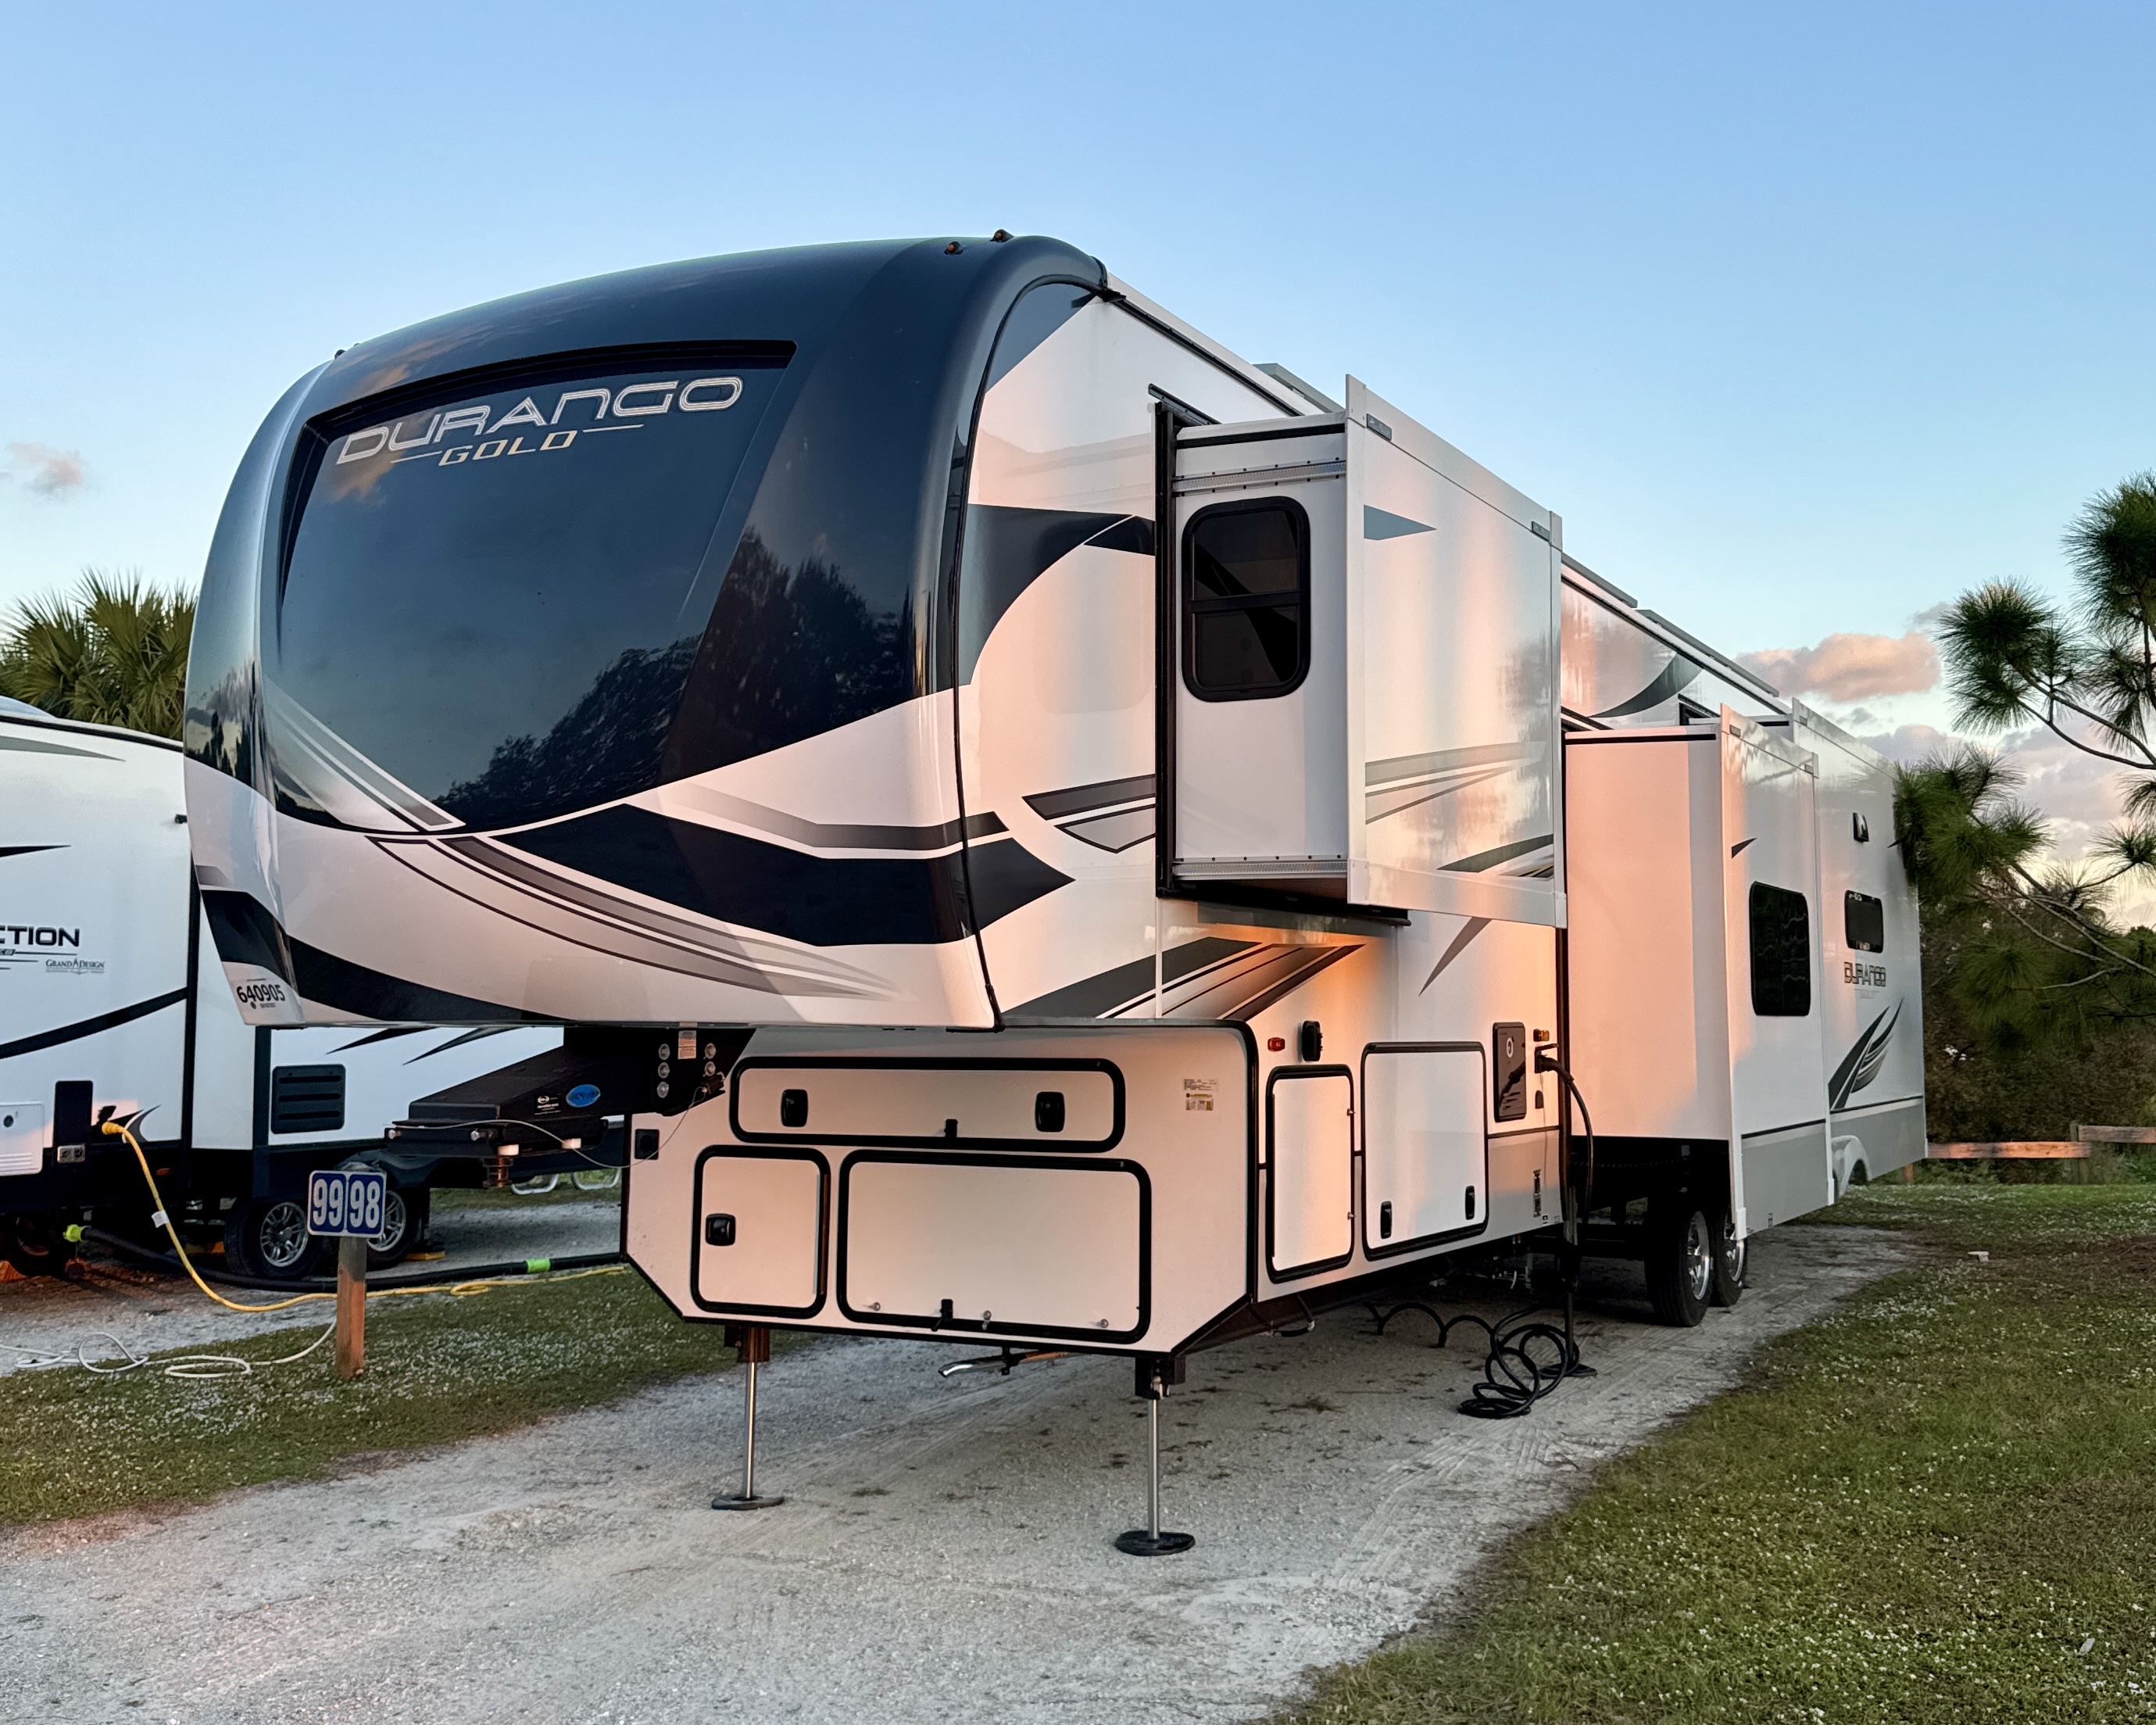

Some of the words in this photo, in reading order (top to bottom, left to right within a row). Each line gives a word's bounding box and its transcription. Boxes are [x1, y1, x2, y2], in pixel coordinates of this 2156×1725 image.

[336, 376, 742, 466] DURANGO
[438, 431, 577, 467] GOLD
[0, 925, 80, 947] TION
[236, 983, 286, 1004] 640905
